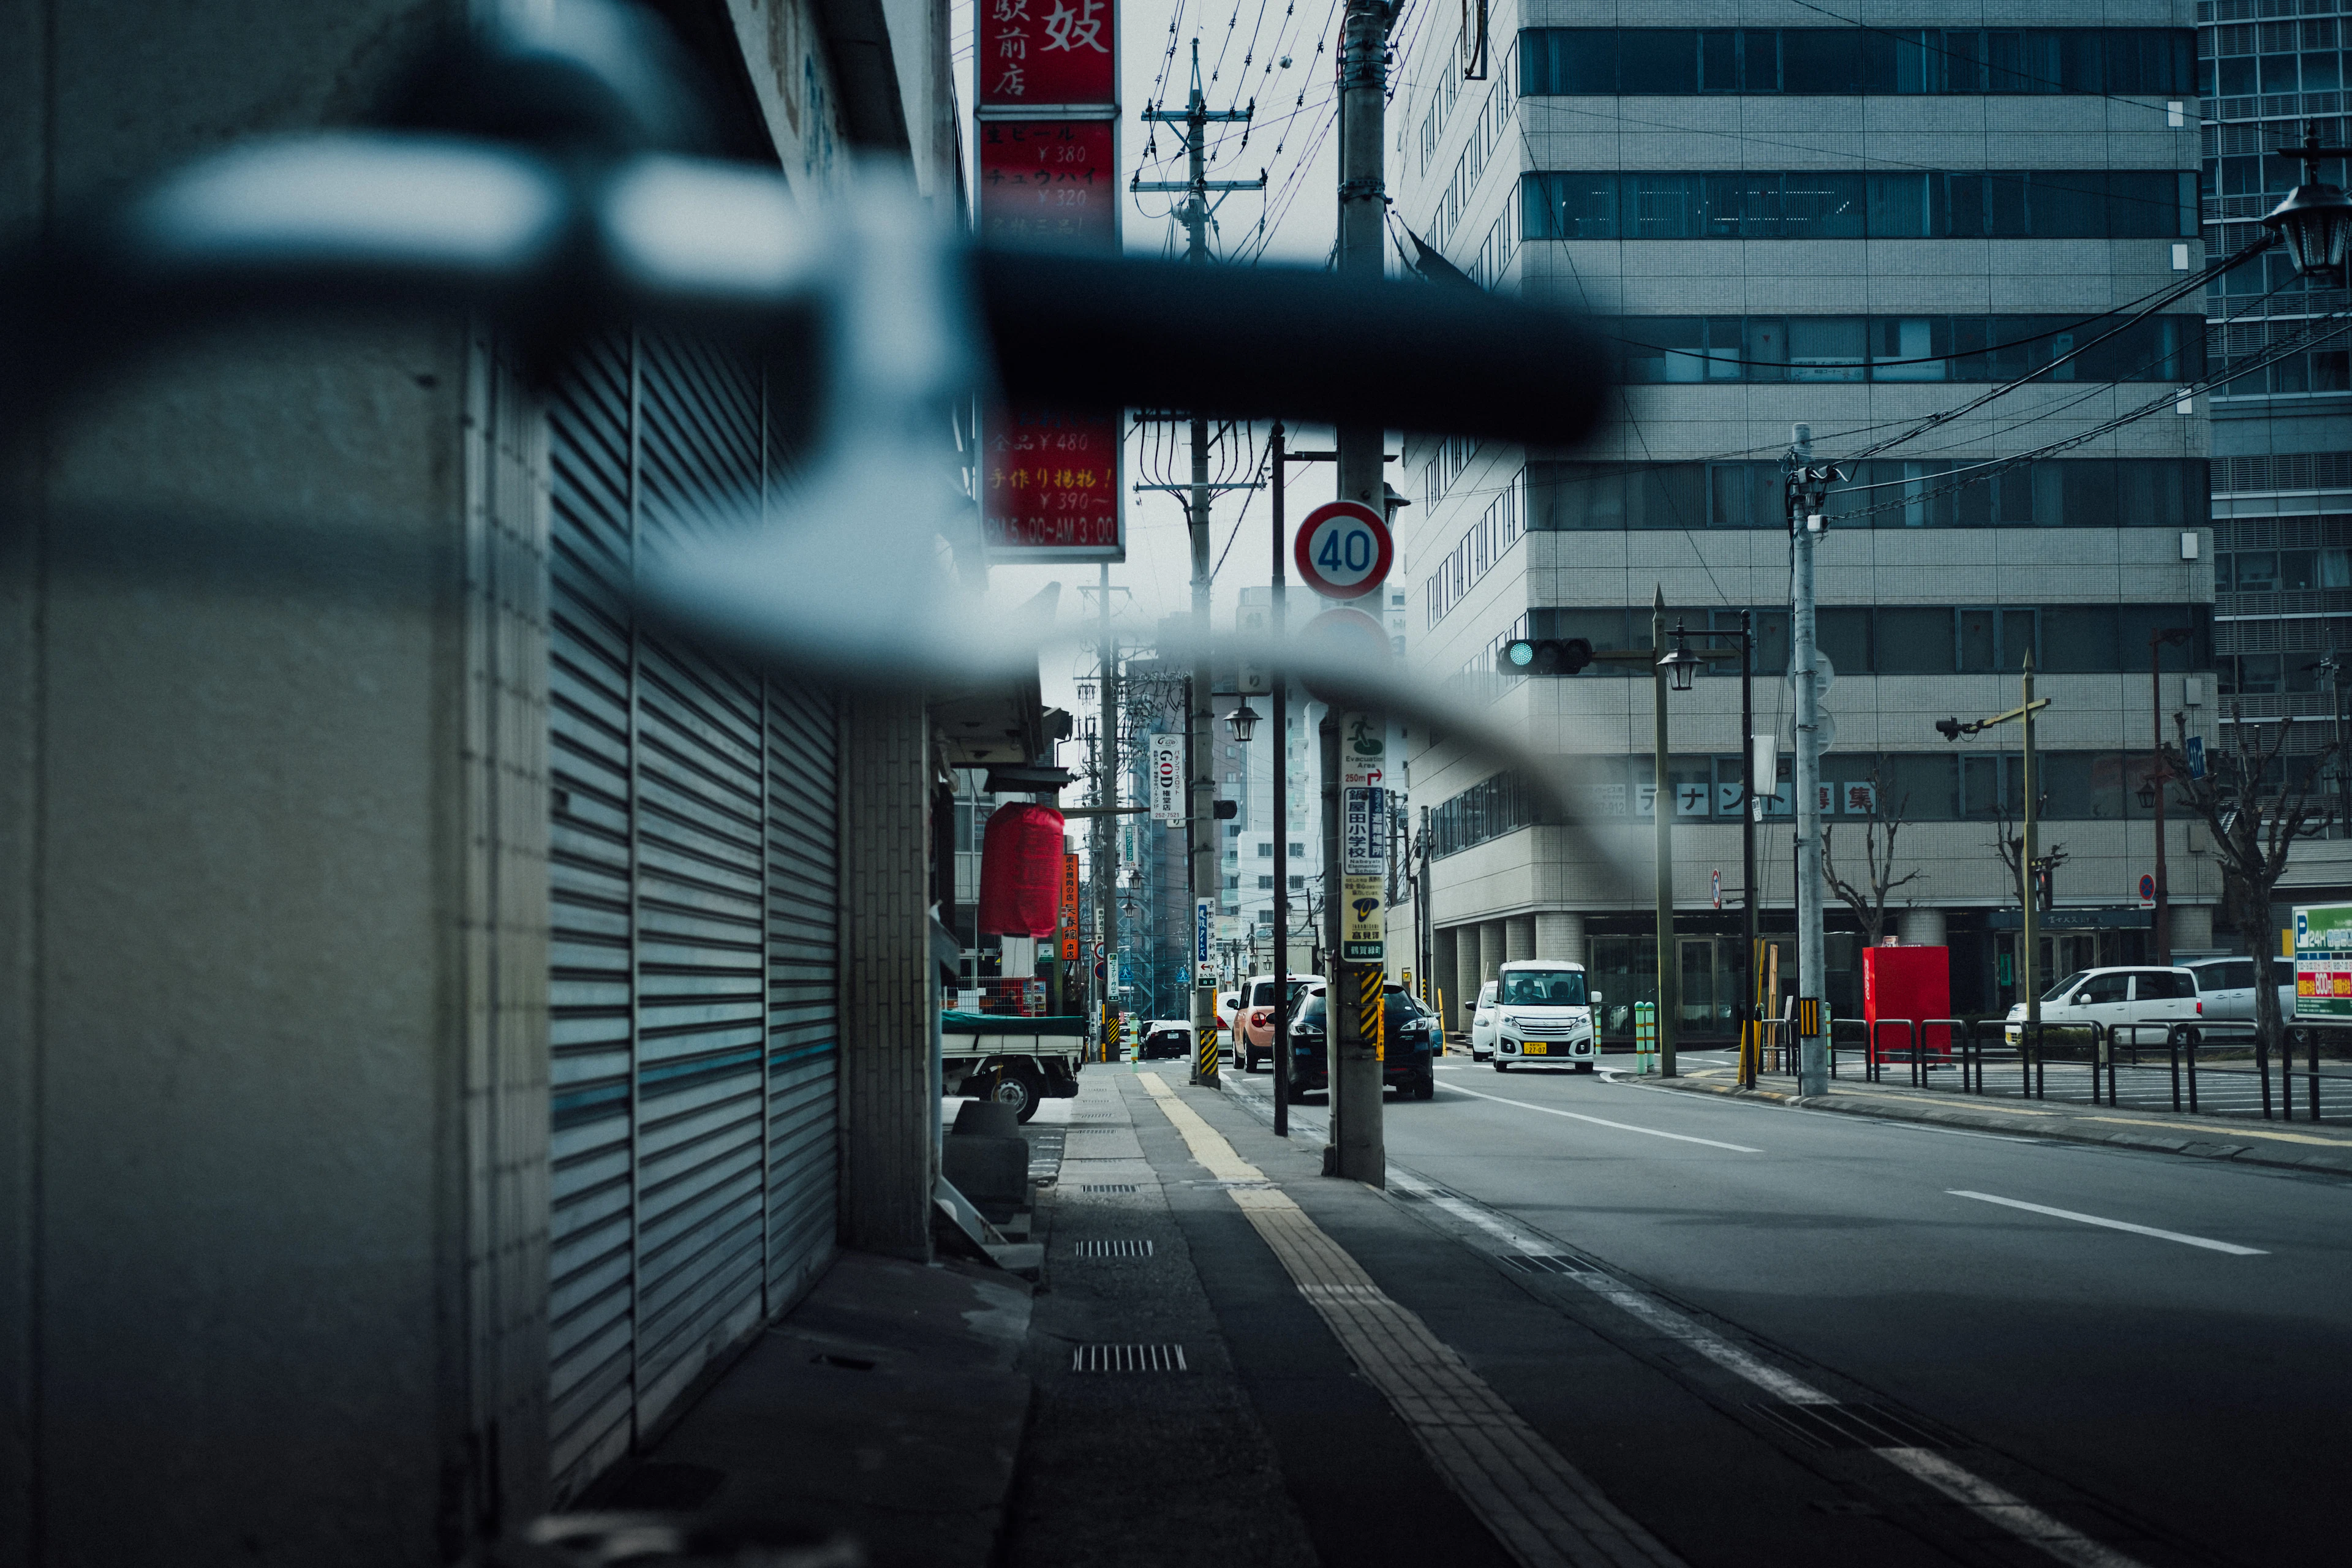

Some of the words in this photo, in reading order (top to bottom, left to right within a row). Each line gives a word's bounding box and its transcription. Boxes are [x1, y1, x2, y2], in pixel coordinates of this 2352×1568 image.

[987, 125, 1074, 144] 生ビール
[986, 167, 1096, 186] チュウハイ
[1318, 529, 1370, 571] 40
[1160, 750, 1173, 788] GOD
[1163, 790, 1171, 811] 権堂店
[1372, 813, 1382, 856] 避難場所
[2297, 915, 2307, 943] P
[2309, 930, 2326, 947] 24H
[1066, 943, 1074, 958] 本店
